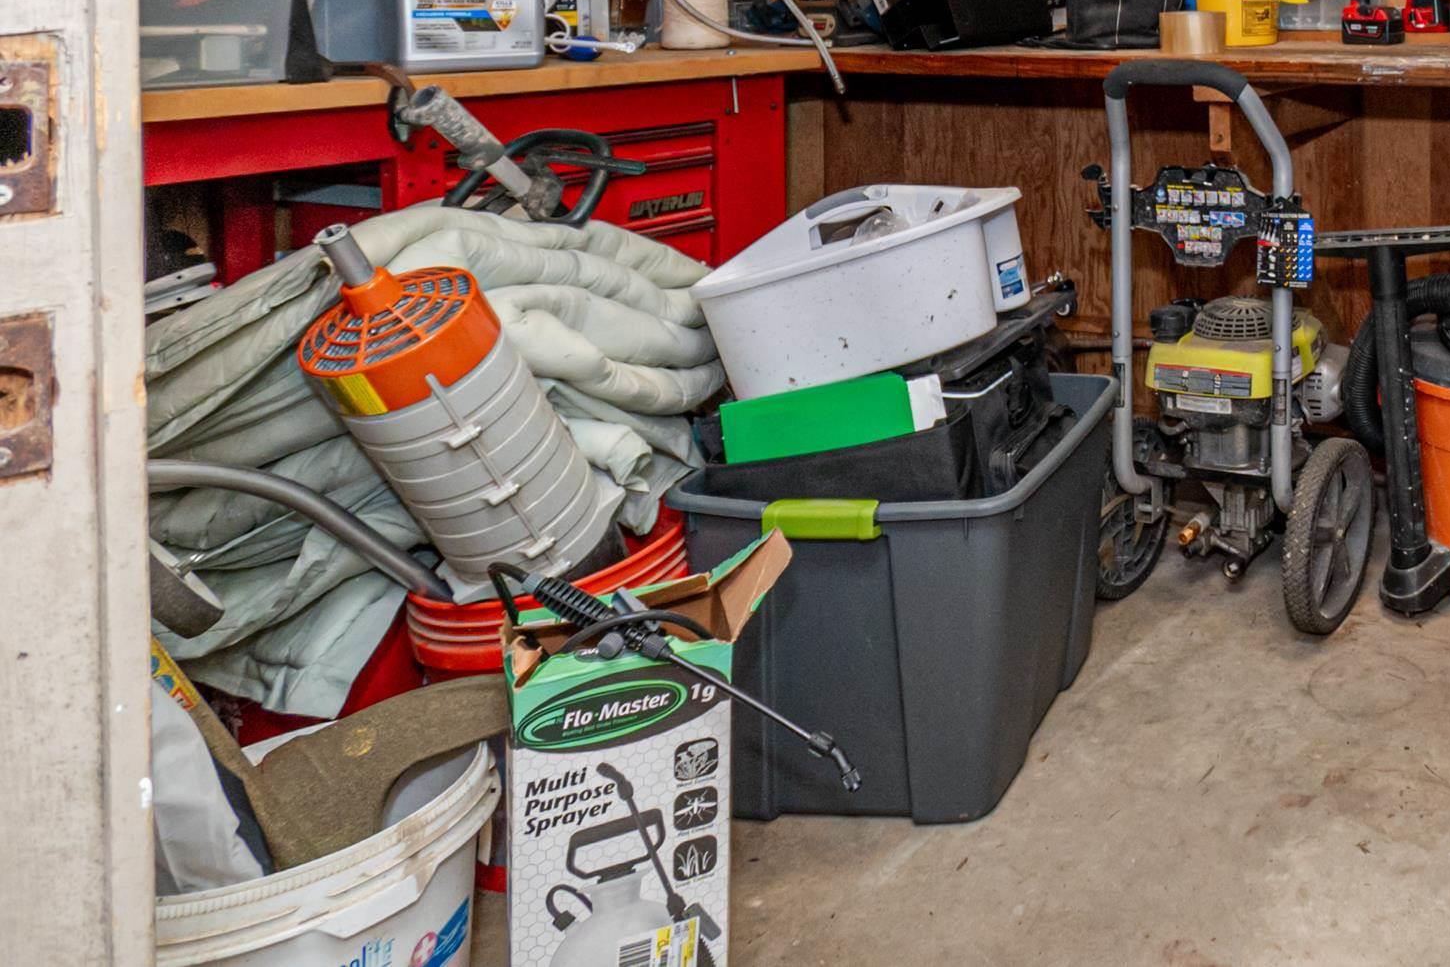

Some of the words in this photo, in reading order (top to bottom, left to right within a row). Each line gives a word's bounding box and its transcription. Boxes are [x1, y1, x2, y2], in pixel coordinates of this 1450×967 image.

[524, 767, 588, 799] Multi
[524, 782, 615, 817] Purpose
[524, 800, 613, 838] Sprayer
